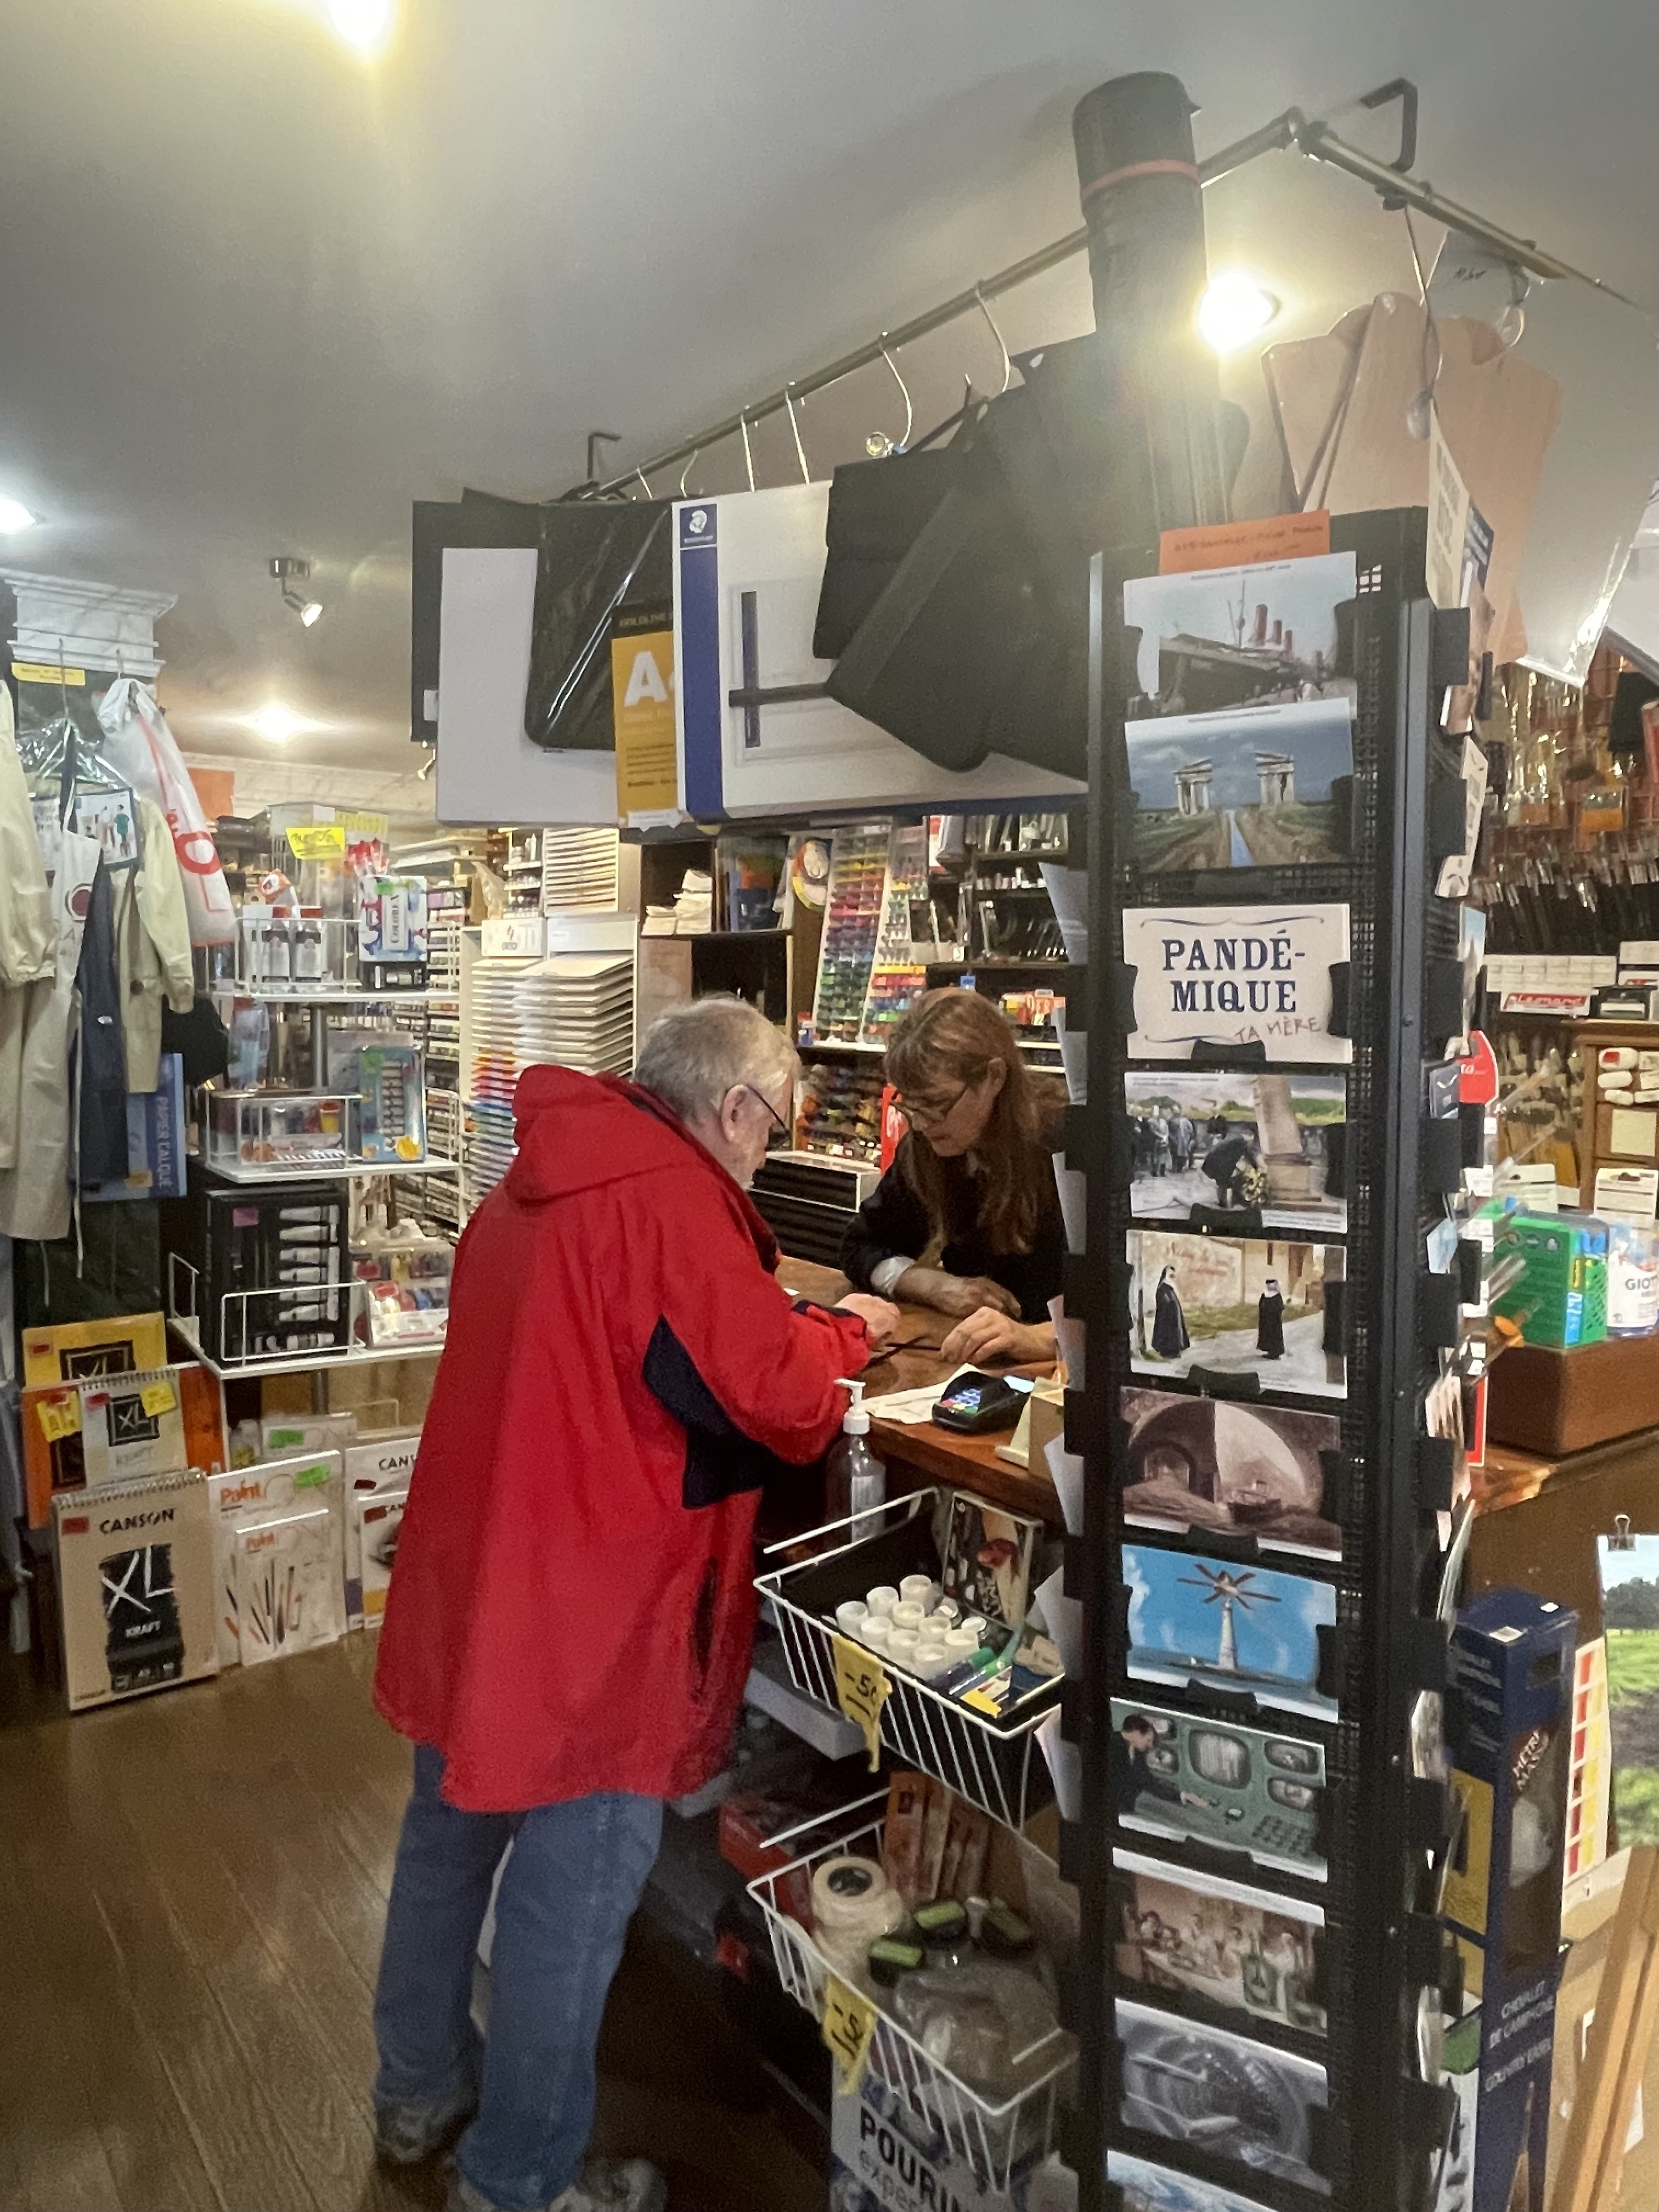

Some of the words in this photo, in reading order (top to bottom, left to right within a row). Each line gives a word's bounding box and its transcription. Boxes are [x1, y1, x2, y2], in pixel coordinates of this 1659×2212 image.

[623, 650, 675, 708] A
[1162, 929, 1306, 971] PANDÉ-
[1170, 980, 1297, 1013] MIQUE
[1234, 1025, 1260, 1043] TA
[1267, 1017, 1322, 1037] MÈRE
[118, 1403, 149, 1431] XL
[99, 1508, 174, 1534] CANSON
[101, 1543, 176, 1615] XL
[125, 1620, 161, 1638] KRAFT
